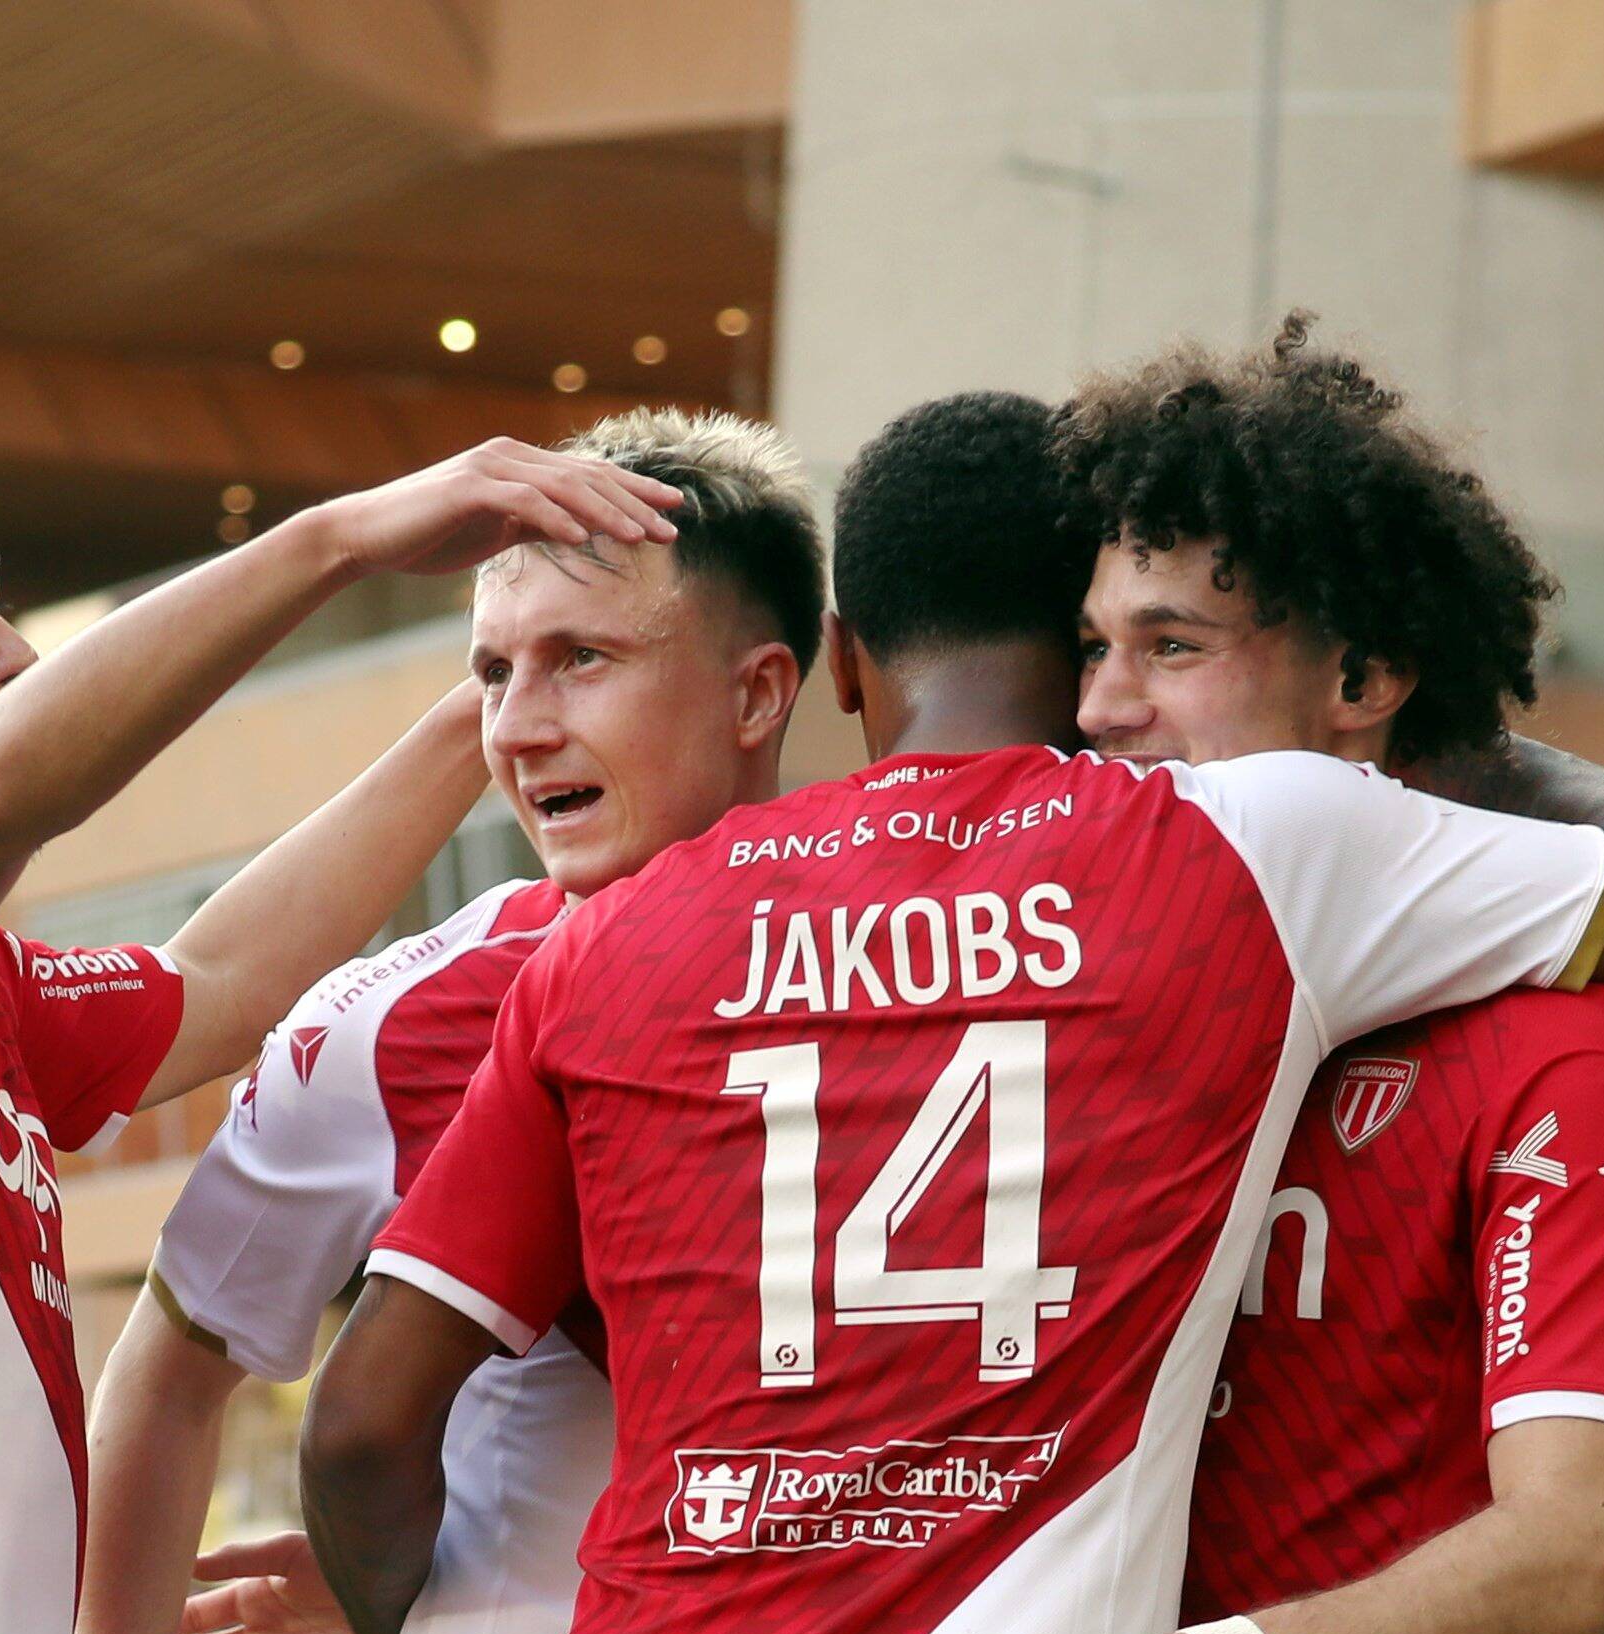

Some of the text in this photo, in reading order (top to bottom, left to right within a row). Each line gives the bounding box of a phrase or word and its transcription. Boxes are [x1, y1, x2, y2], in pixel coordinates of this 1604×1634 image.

[727, 794, 1074, 867] BANG & OLUFSEN
[719, 1019, 1079, 1388] 14
[875, 1457, 1007, 1499] Caribb
[770, 1517, 936, 1541] INTERNAT
